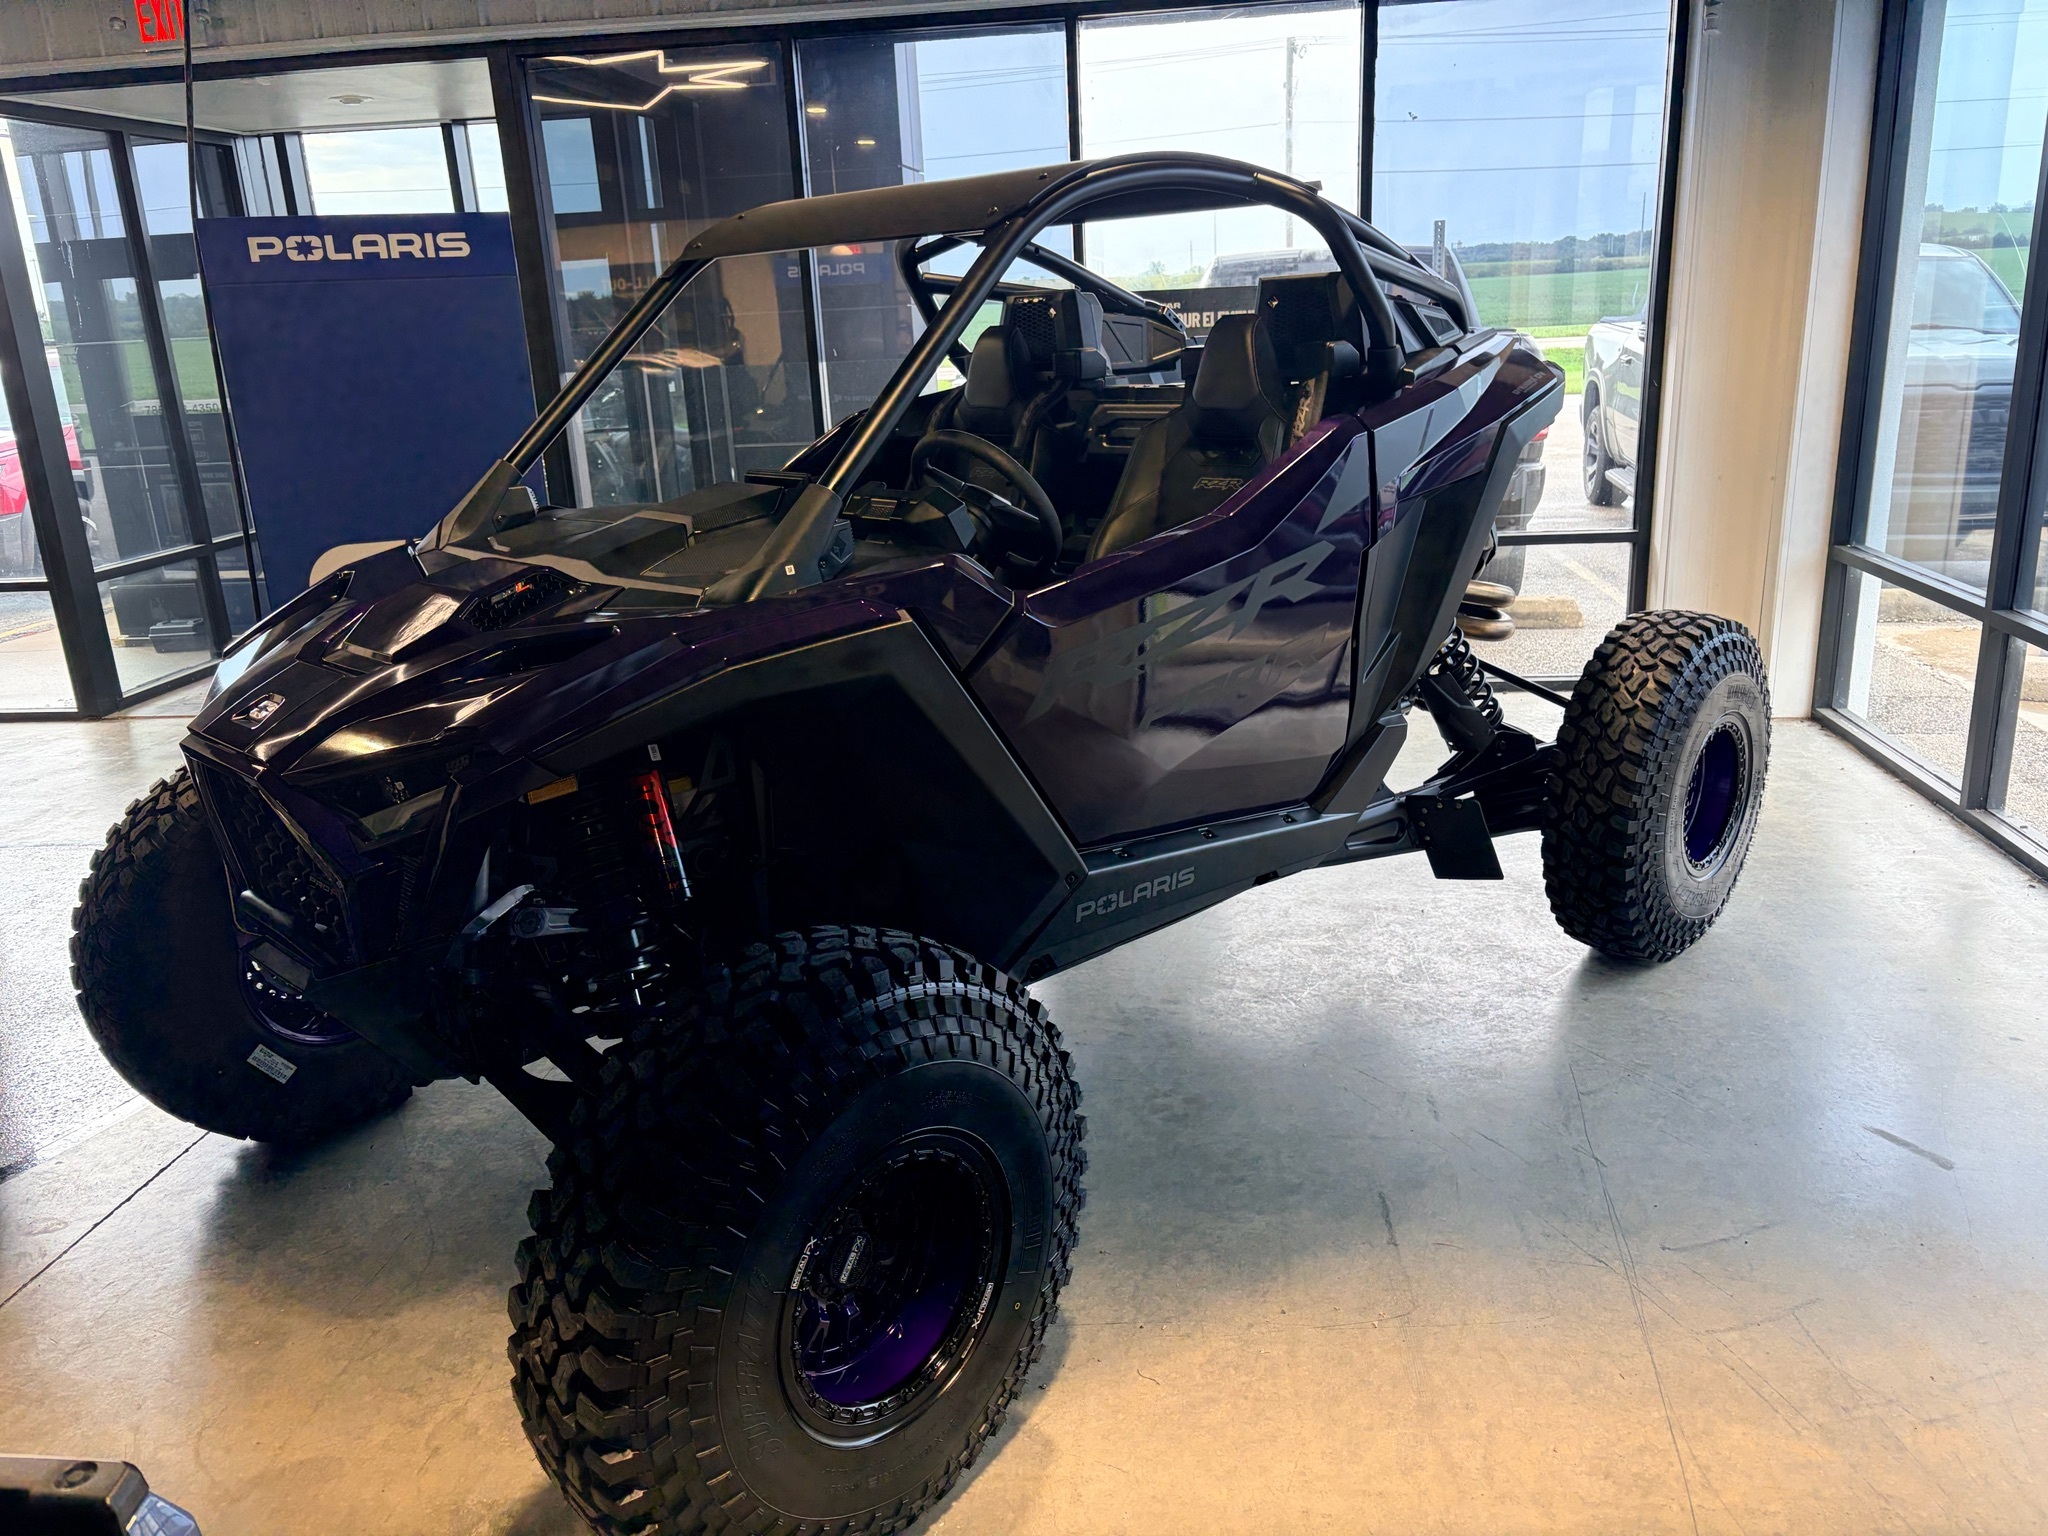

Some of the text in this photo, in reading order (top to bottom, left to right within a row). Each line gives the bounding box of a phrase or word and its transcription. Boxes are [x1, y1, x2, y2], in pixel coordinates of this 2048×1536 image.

[246, 231, 471, 263] POLARIS
[1193, 476, 1244, 490] RZR
[1075, 866, 1195, 923] POLARIS
